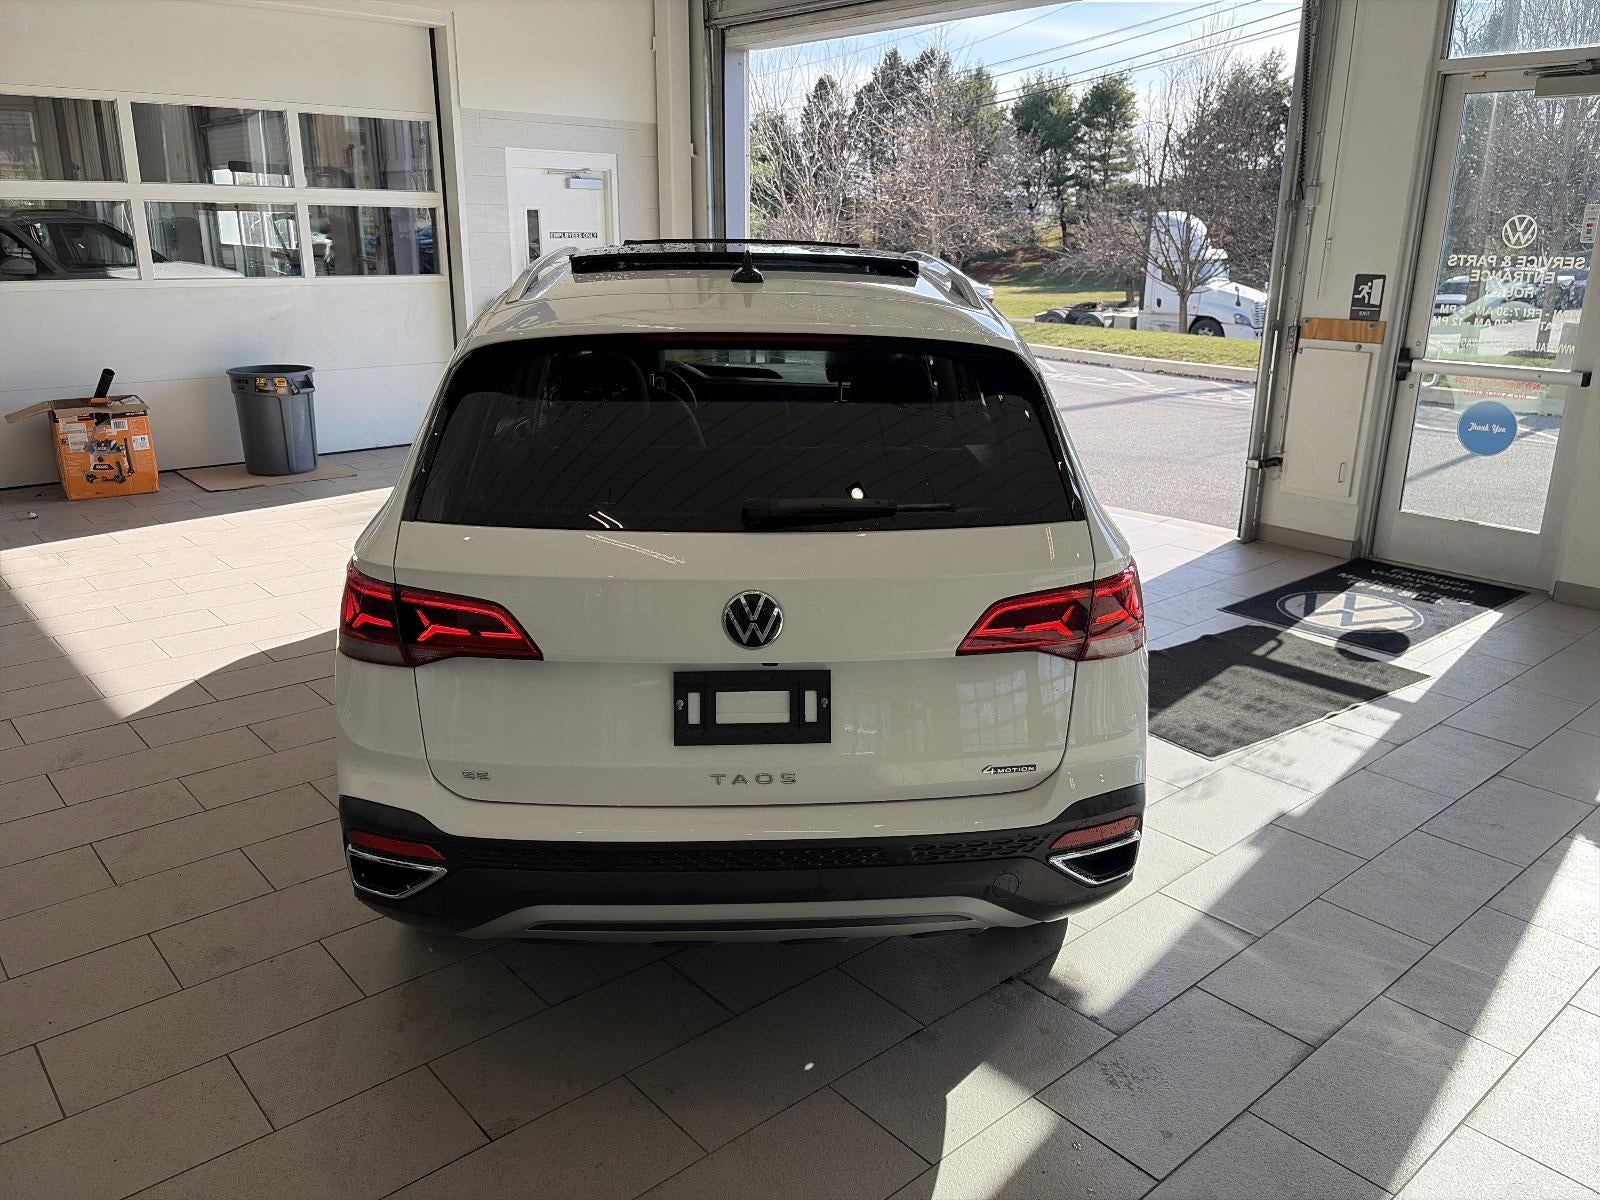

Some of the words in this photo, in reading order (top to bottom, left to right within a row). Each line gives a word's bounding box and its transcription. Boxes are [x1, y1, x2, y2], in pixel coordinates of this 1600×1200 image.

[549, 231, 582, 239] EMPLOYEES
[1467, 422, 1490, 432] Thank
[1491, 423, 1507, 435] You
[462, 769, 491, 781] SE
[708, 772, 797, 786] TAOS
